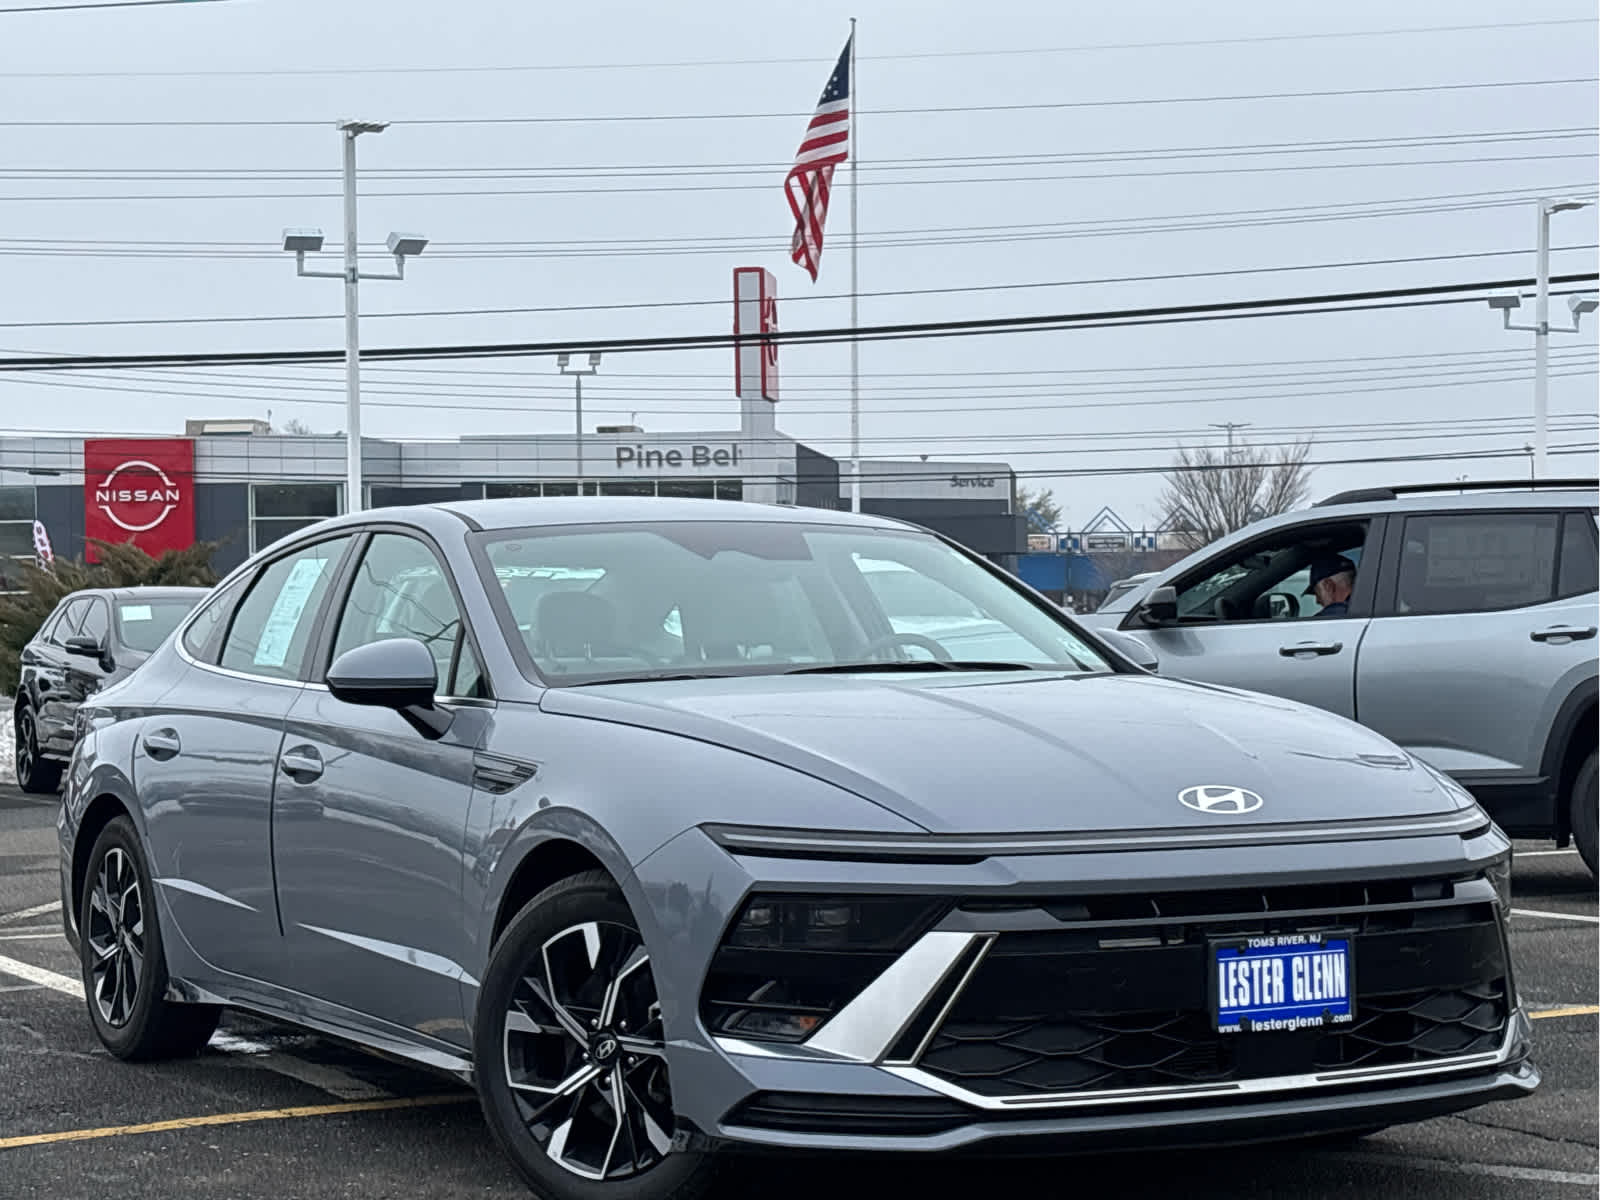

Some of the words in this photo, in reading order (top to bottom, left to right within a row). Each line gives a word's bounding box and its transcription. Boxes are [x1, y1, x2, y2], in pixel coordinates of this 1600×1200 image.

[616, 444, 682, 468] Pine
[691, 443, 742, 467] Bel
[951, 474, 994, 488] Service
[96, 489, 179, 502] NISSAN
[1248, 938, 1275, 948] TOMS
[1309, 934, 1321, 943] NJ
[1219, 959, 1285, 1008] LESTER
[1292, 953, 1346, 1001] GLENN
[1251, 1016, 1323, 1032] lesterglenn
